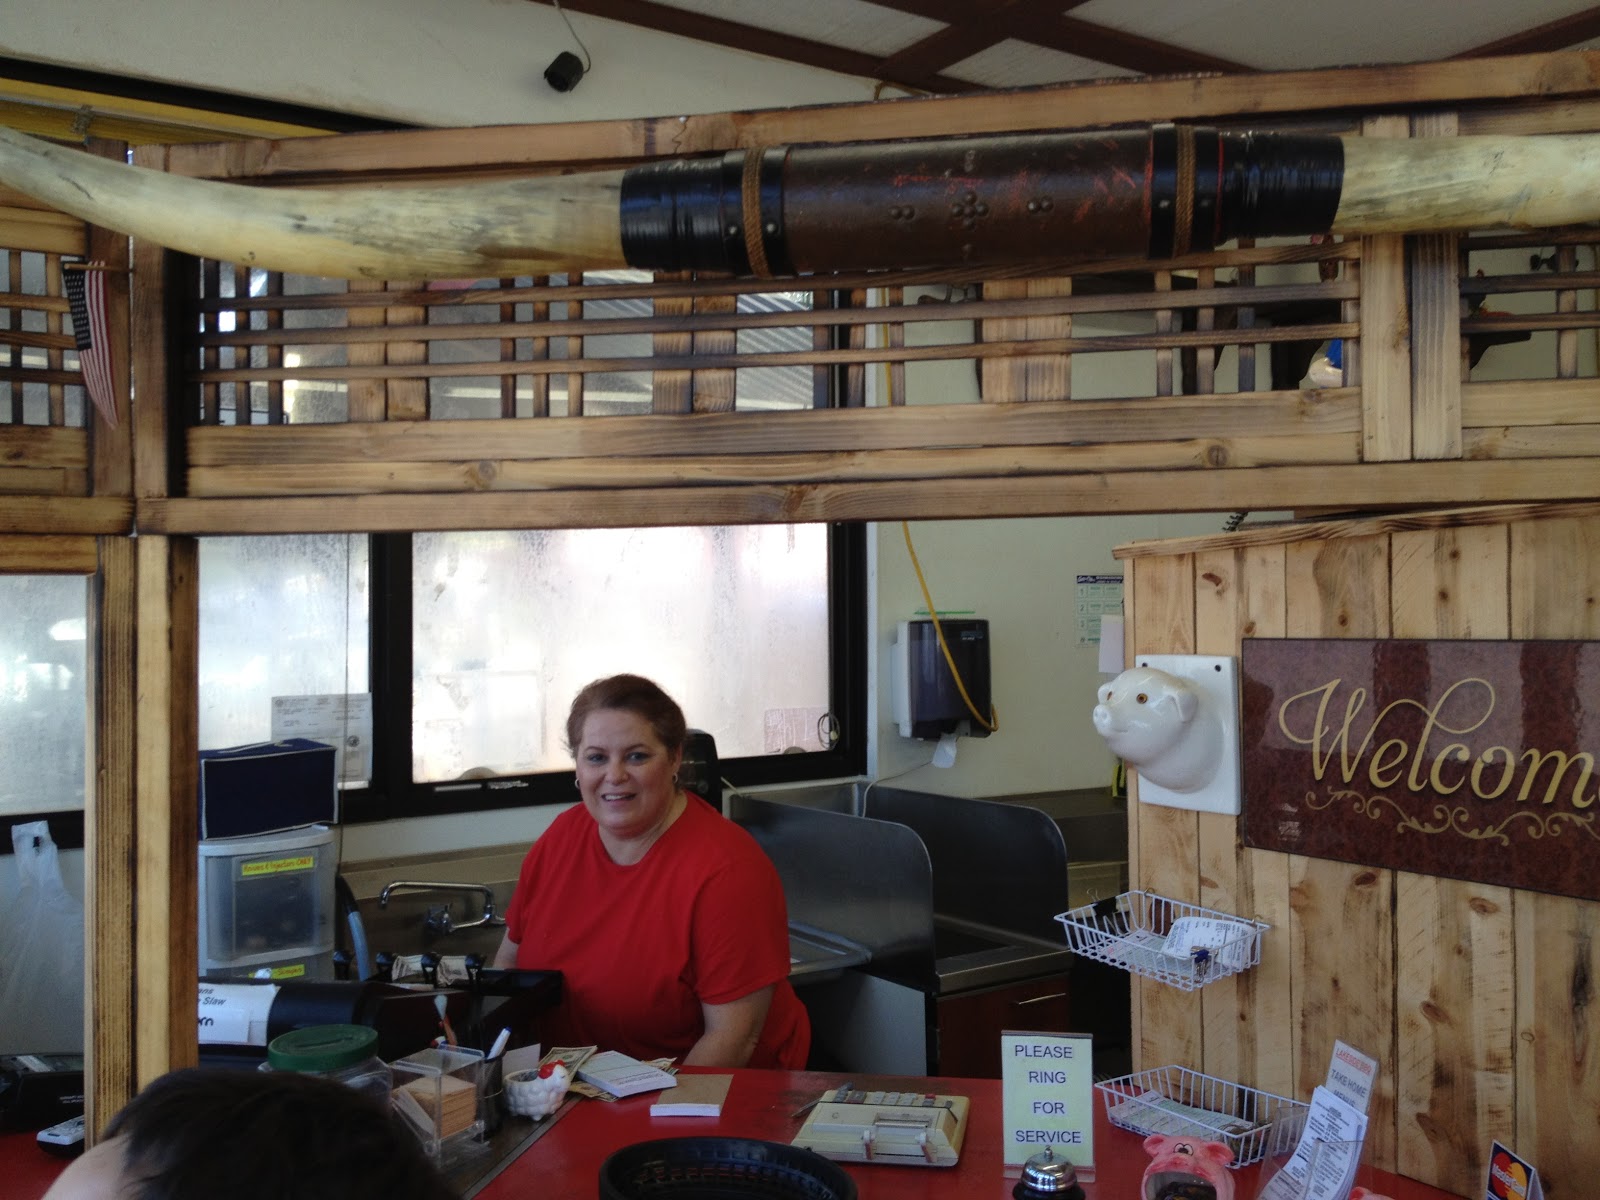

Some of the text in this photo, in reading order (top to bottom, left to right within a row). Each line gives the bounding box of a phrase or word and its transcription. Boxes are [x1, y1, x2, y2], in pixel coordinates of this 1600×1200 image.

[1279, 677, 1600, 809] Welcom
[203, 996, 227, 1006] Slaw
[1015, 1044, 1073, 1059] PLEASE
[1029, 1071, 1067, 1084] RING
[1033, 1101, 1066, 1114] FOR
[1015, 1130, 1082, 1144] SERVICE
